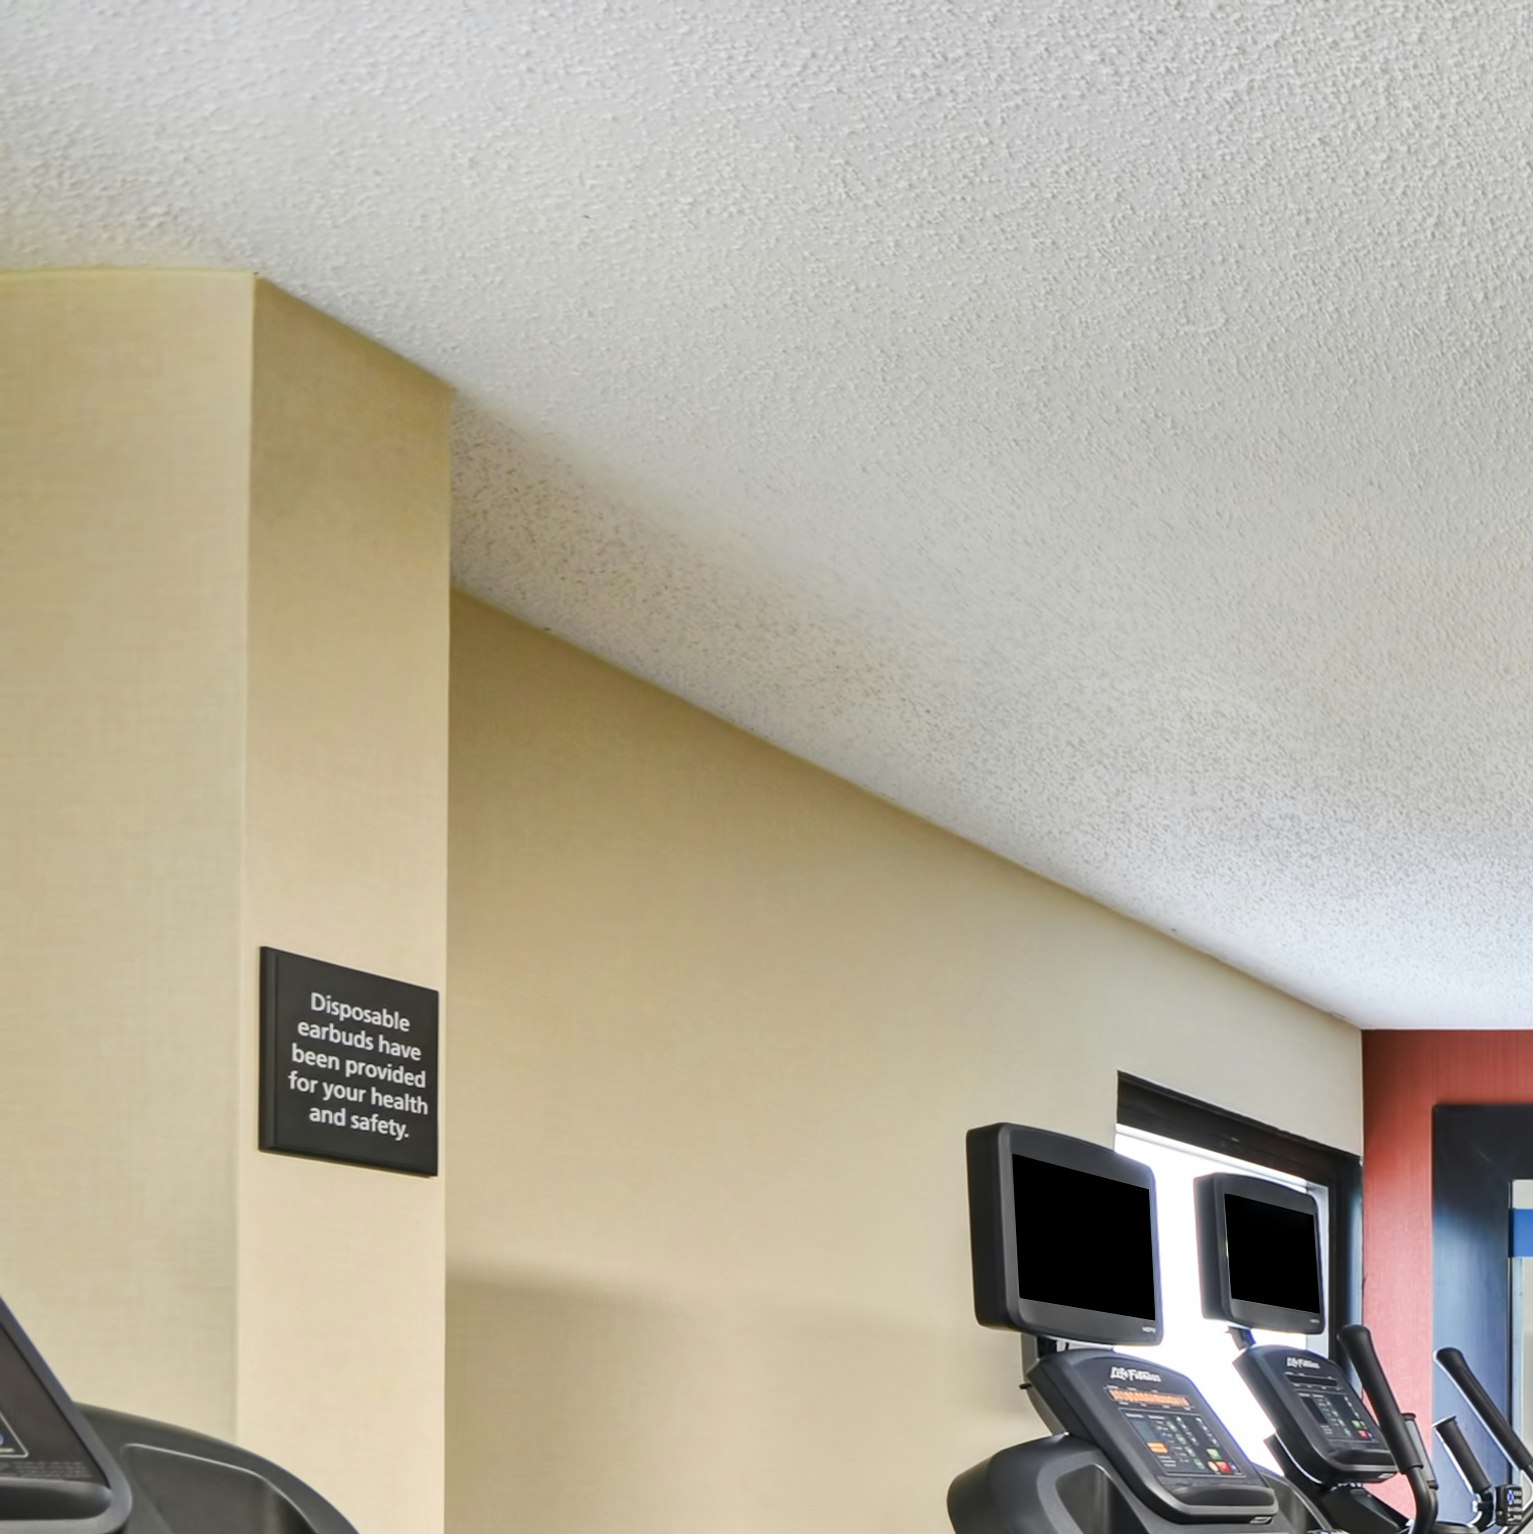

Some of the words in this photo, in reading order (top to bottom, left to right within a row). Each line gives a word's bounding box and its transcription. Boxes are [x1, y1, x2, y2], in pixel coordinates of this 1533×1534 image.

[310, 992, 411, 1032] Disposable
[297, 1020, 374, 1050] earbuds
[378, 1035, 421, 1061] have
[291, 1042, 340, 1071] been
[345, 1059, 426, 1089] provided
[287, 1070, 318, 1093] for
[322, 1081, 366, 1103] your
[371, 1086, 428, 1115] health
[309, 1107, 346, 1127] and
[350, 1114, 409, 1141] safety.
